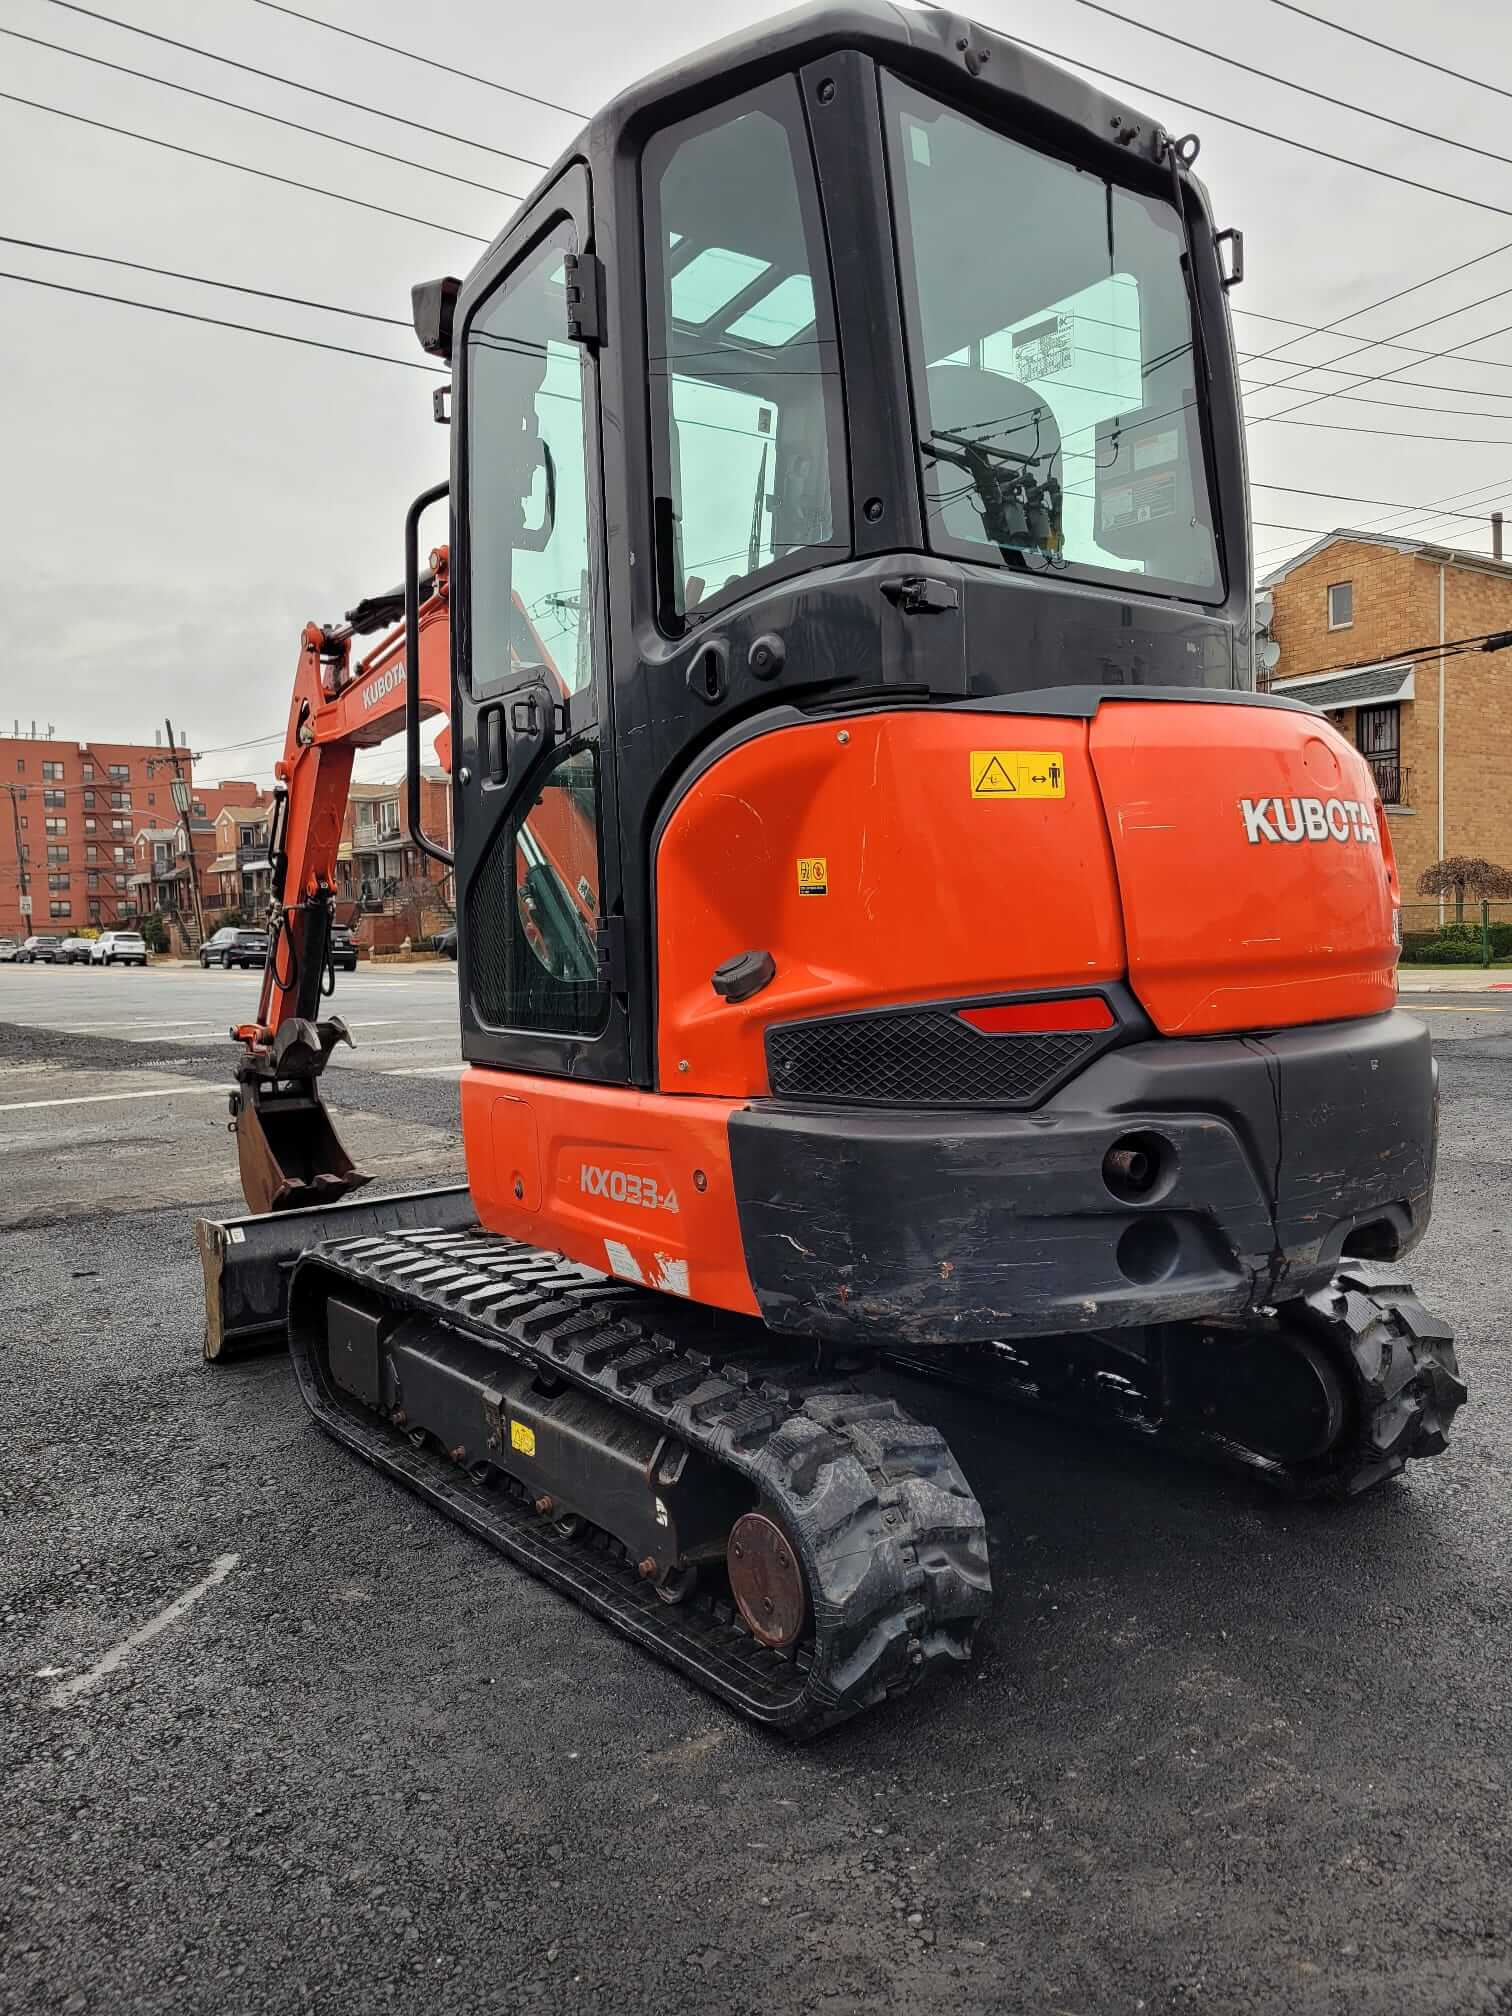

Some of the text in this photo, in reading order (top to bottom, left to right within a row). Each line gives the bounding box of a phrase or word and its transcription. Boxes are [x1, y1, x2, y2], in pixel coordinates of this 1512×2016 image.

[363, 662, 406, 709] KUBOTA
[1241, 798, 1377, 843] KUBOTA
[580, 1164, 679, 1213] KX033-4
